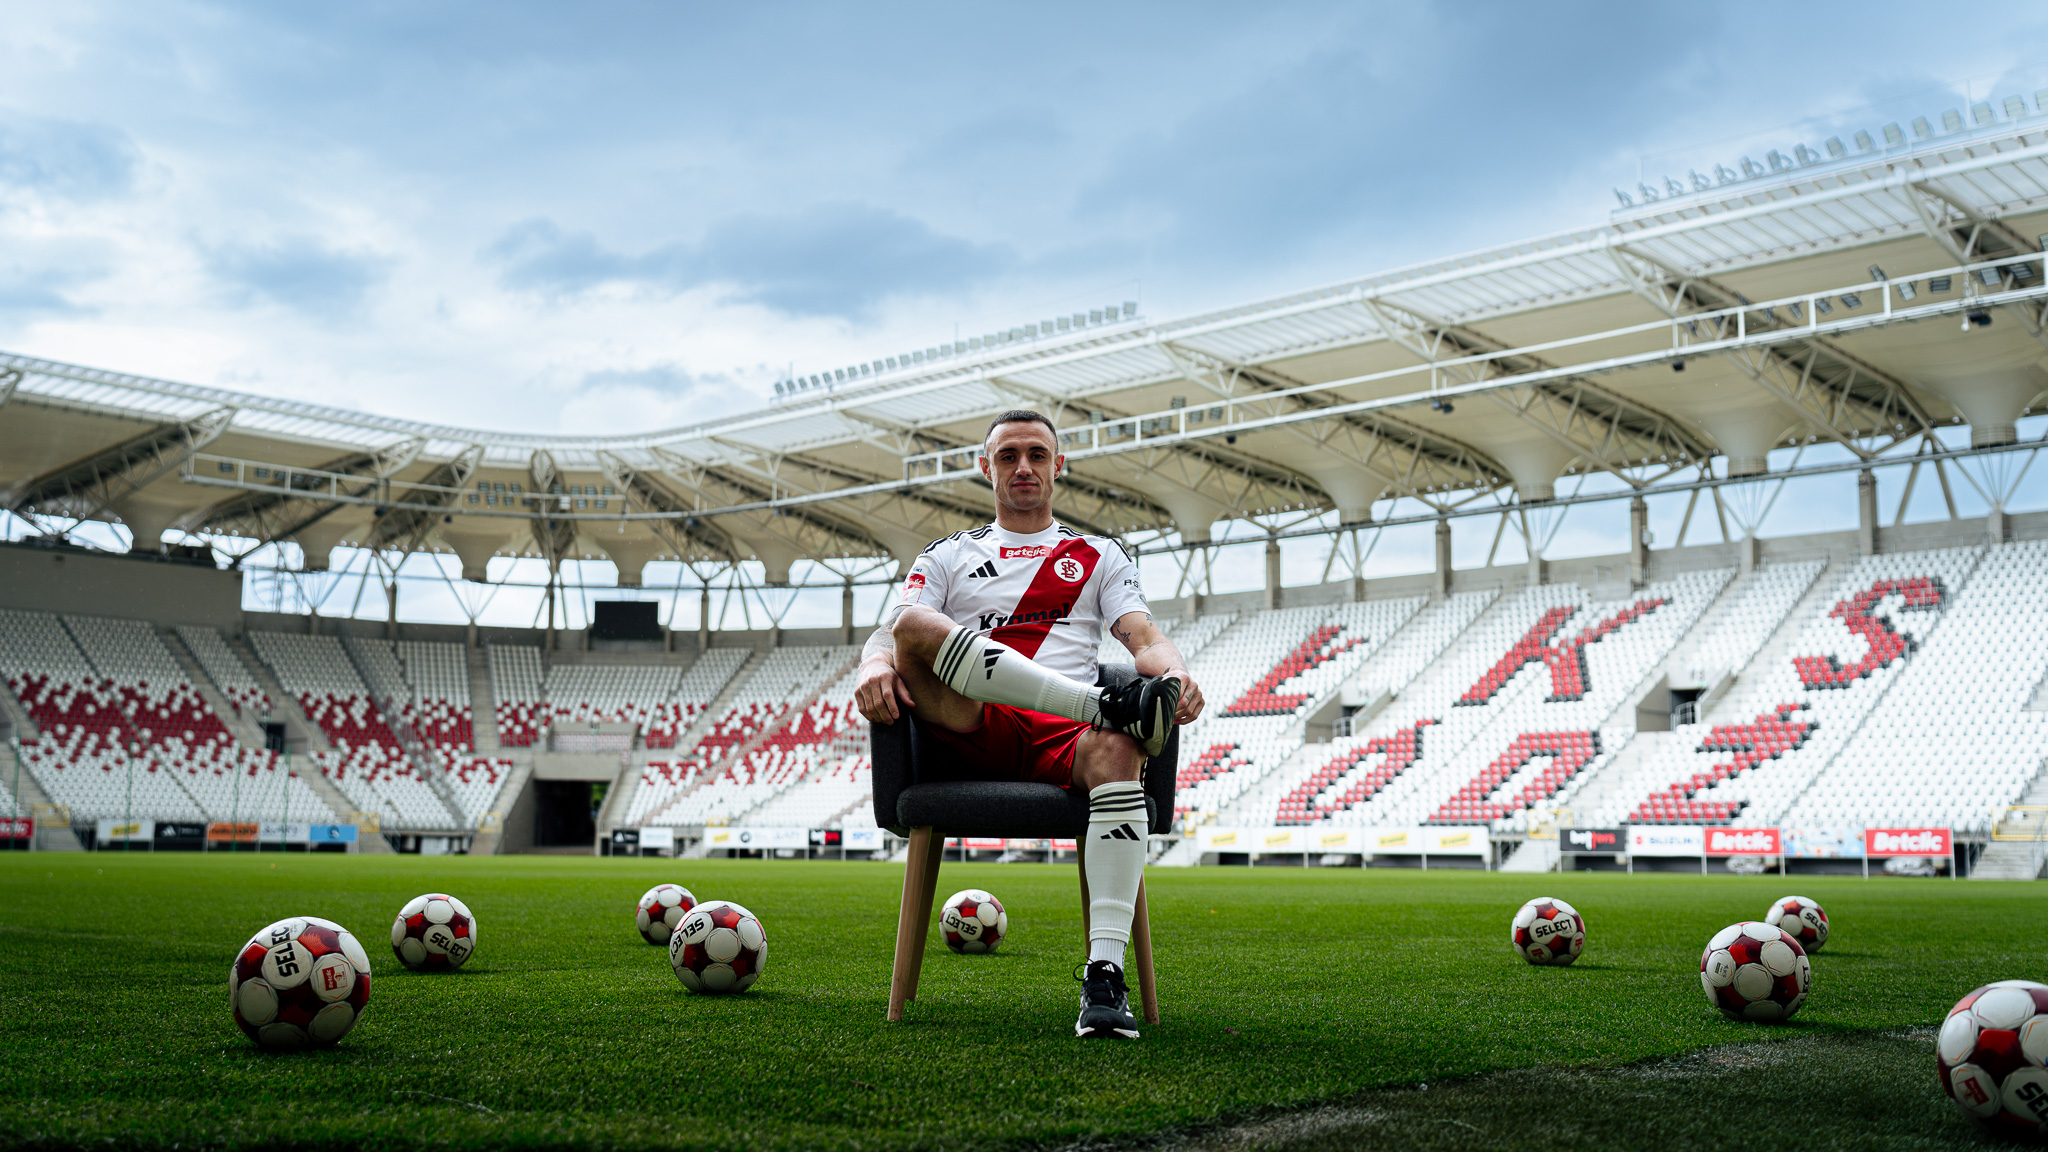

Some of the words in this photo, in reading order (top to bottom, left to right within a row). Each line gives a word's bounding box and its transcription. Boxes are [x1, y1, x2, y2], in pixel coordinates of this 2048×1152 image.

[1005, 547, 1047, 557] Betclic
[1711, 831, 1774, 851] Betclic
[1873, 831, 1943, 852] Betclic
[946, 914, 978, 936] SELECT
[1535, 919, 1572, 938] SELECT
[1804, 912, 1829, 935] SELECT
[429, 932, 468, 959] SELECT
[670, 917, 705, 960] SELECT
[271, 926, 300, 978] SELEC
